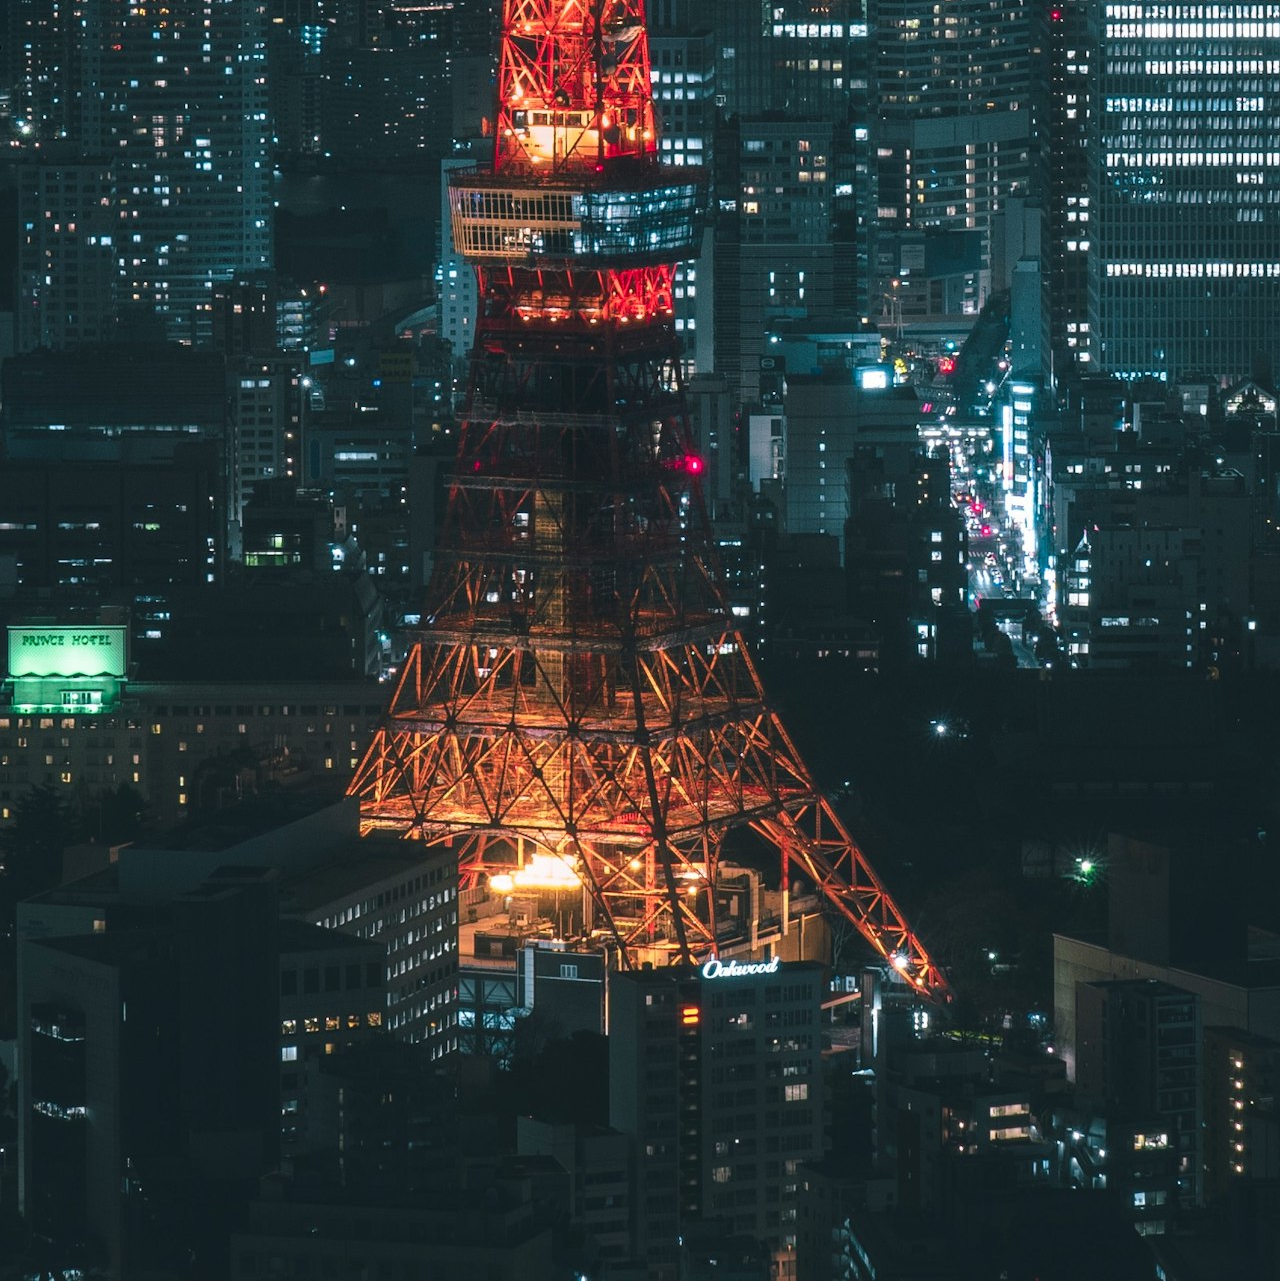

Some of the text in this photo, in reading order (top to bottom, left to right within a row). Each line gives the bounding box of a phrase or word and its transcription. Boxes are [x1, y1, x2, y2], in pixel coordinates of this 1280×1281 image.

[22, 634, 112, 646] PRINCE HOTEL
[702, 955, 780, 979] Oakwood
